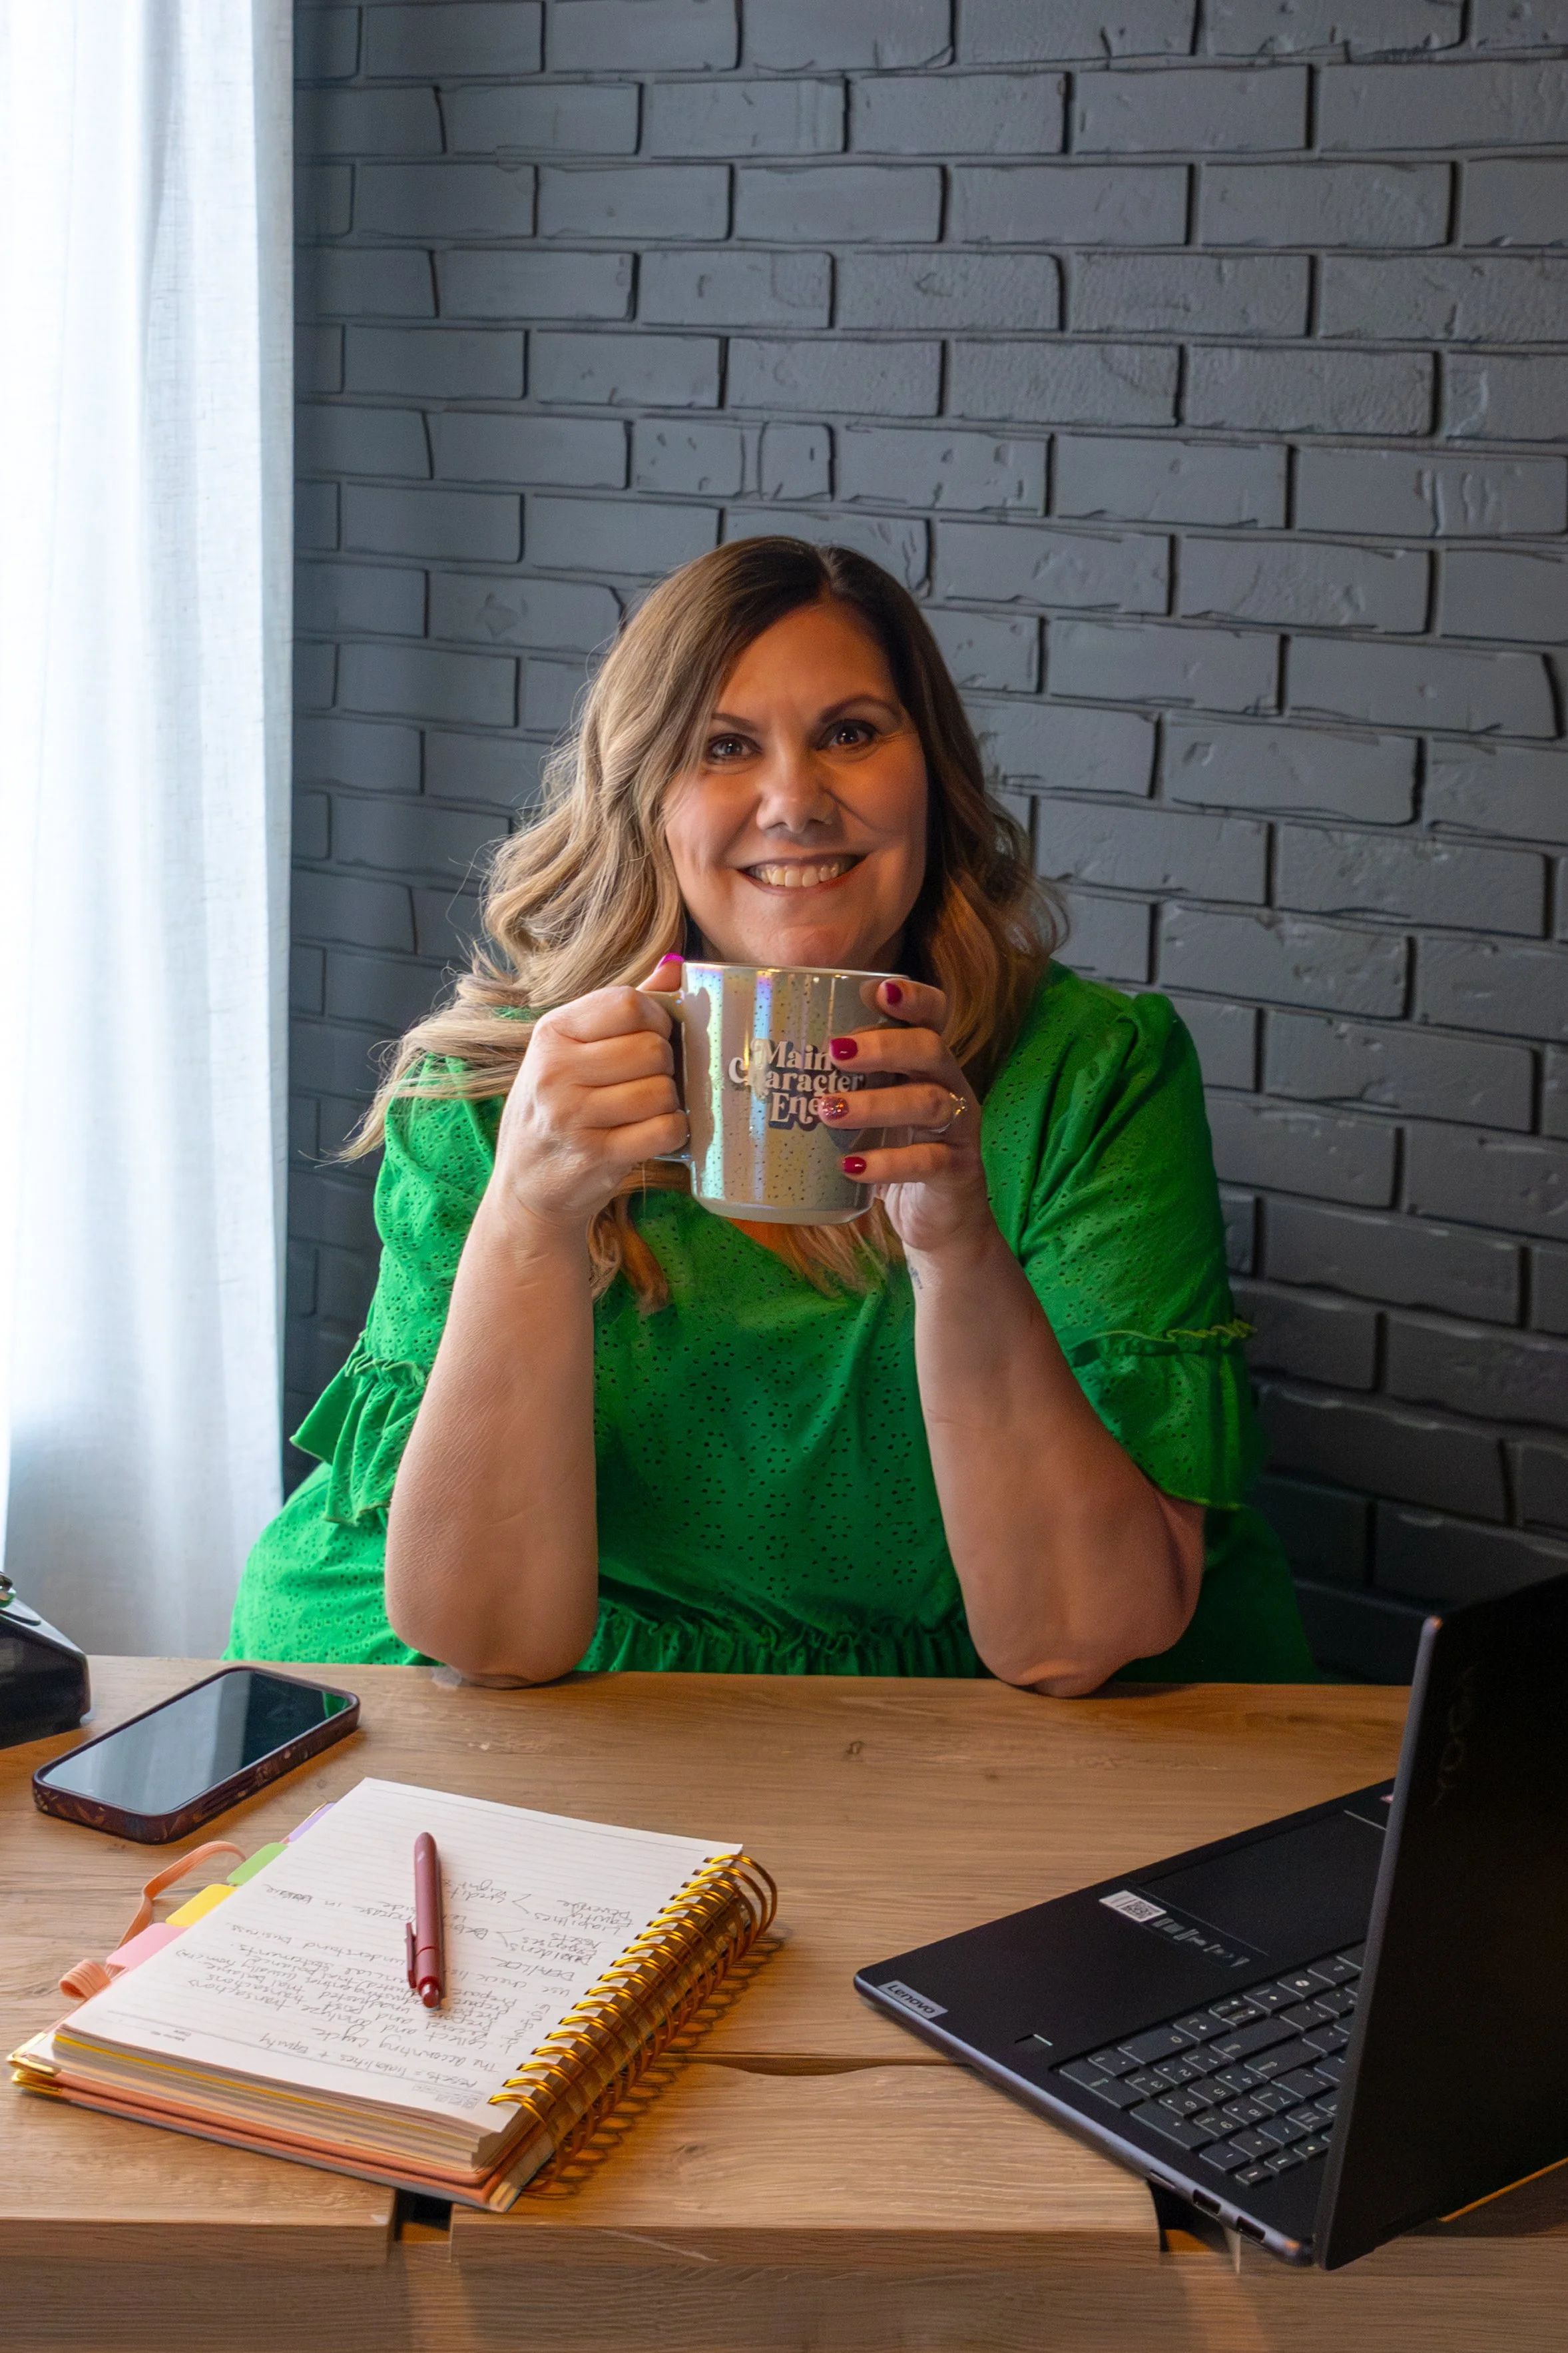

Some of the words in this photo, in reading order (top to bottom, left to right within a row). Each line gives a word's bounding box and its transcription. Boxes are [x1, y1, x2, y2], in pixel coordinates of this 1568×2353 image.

[750, 1038, 833, 1071] Main
[770, 1092, 821, 1124] Ene
[887, 1985, 935, 2014] Lenovo
[374, 2013, 414, 2024] and
[379, 2024, 417, 2038] and
